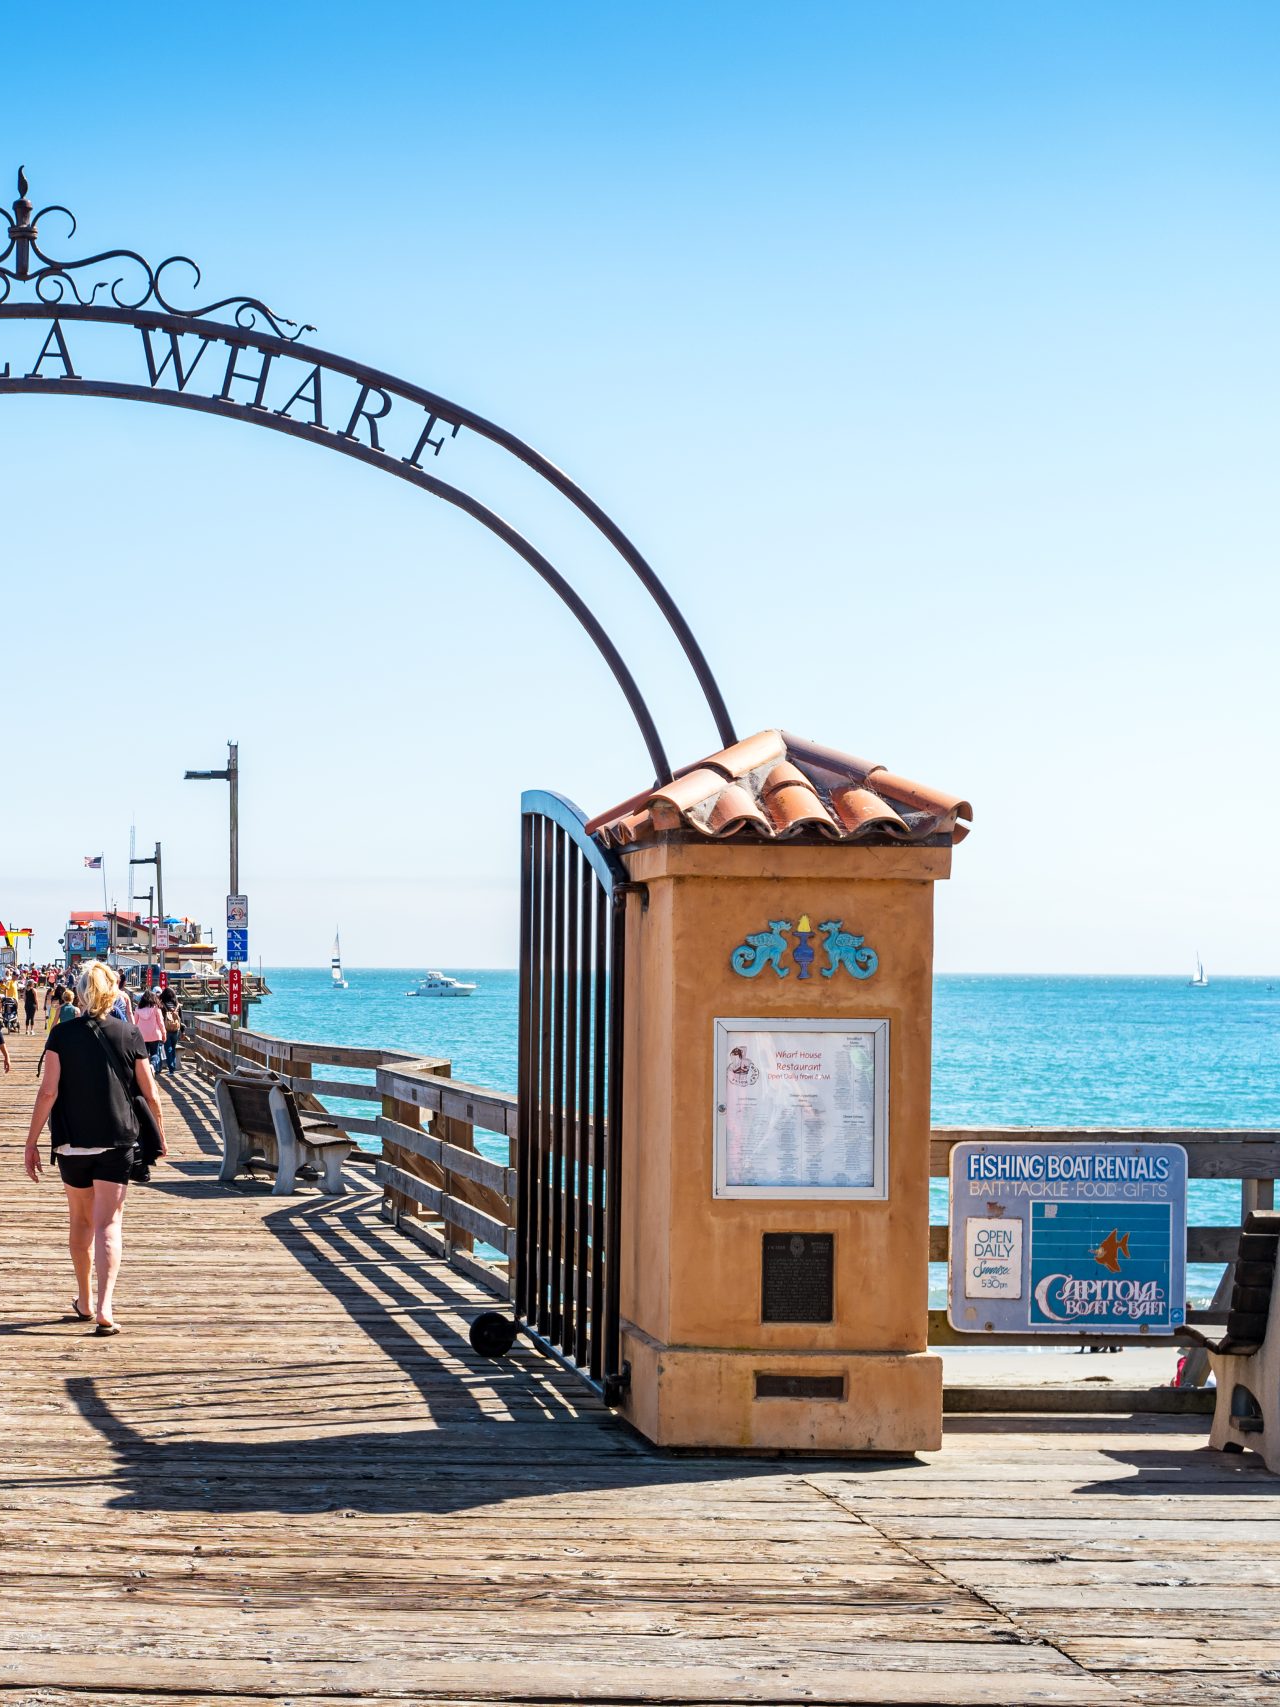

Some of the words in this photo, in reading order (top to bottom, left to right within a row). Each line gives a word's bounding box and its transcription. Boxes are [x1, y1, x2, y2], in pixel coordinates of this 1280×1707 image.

[133, 322, 463, 470] WHARF
[232, 972, 238, 981] 3
[775, 1050, 798, 1059] Wharf
[799, 1051, 822, 1059] House
[776, 1062, 822, 1071] Restaurant
[767, 1073, 783, 1081] Open
[783, 1073, 799, 1082] Daily
[968, 1154, 1045, 1180] FISHING
[1046, 1154, 1093, 1180] BOAT
[1093, 1156, 1170, 1180] RENTALS
[969, 1181, 1005, 1197] BAIT
[1011, 1181, 1069, 1197] TACKLE
[1076, 1182, 1117, 1197] FOOD
[1123, 1183, 1168, 1197] GIFTS
[977, 1229, 1013, 1244] OPEN
[974, 1243, 1015, 1258] DAILY
[972, 1260, 1010, 1278] Sunrise
[1064, 1300, 1110, 1315] BOAT
[1111, 1300, 1127, 1316] &
[1127, 1300, 1166, 1319] BAIT
